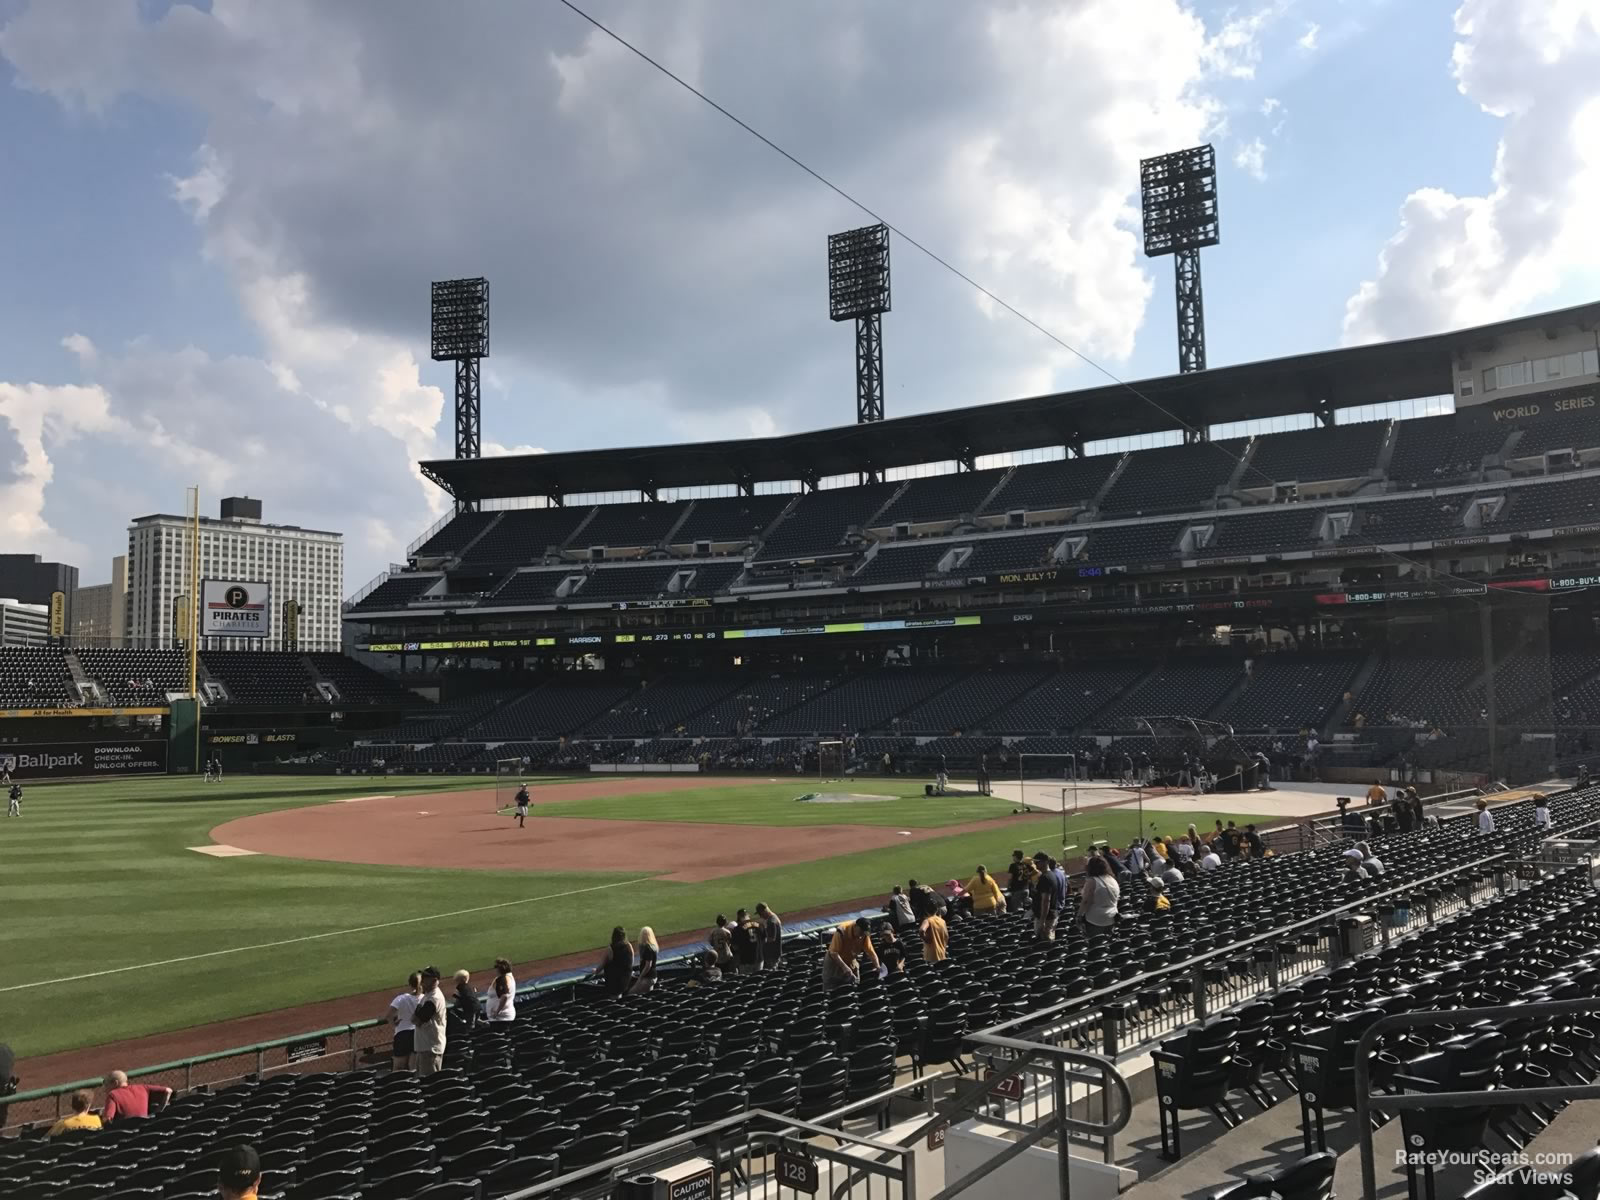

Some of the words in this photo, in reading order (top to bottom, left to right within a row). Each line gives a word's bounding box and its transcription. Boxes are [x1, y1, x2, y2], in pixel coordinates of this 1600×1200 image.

[1493, 405, 1540, 421] WORLD
[1554, 396, 1596, 412] SERIES
[1000, 575, 1021, 583] MON.
[1023, 573, 1043, 582] JULY
[1048, 571, 1057, 579] 17
[1552, 577, 1600, 588] 1-800-BUY-
[232, 591, 242, 604] P
[213, 612, 260, 622] PIRATES
[94, 746, 143, 754] DOWNLOAD.
[18, 752, 83, 769] Ballpark
[94, 754, 134, 762] CHECK-IN.
[294, 1042, 320, 1053] CAUTION
[934, 1129, 945, 1142] 28
[783, 1161, 806, 1182] 128
[673, 1176, 711, 1198] CAUTION
